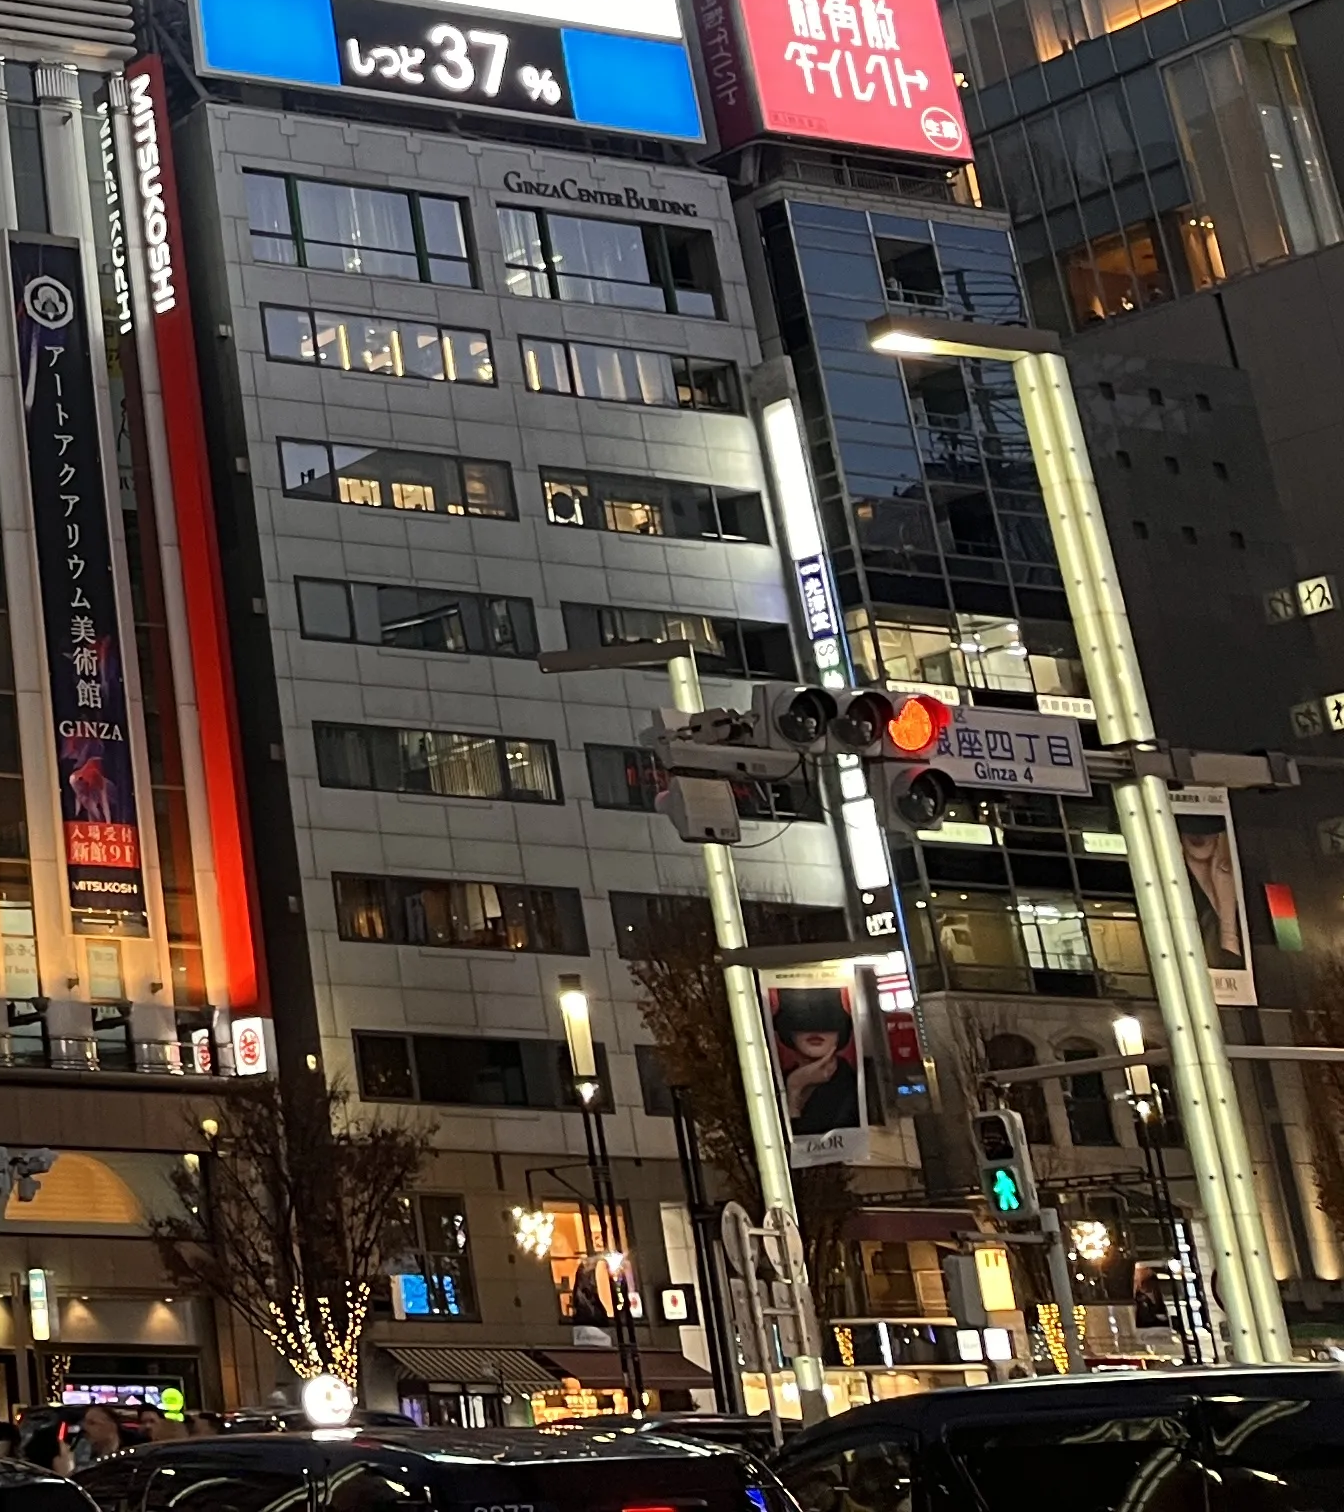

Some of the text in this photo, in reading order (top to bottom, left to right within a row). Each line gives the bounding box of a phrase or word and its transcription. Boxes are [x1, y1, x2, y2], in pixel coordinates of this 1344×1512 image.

[426, 21, 510, 98] 37
[517, 62, 562, 106] %
[129, 72, 176, 314] MITSUKOSHI
[44, 345, 102, 709] アートアクアリウム美術館
[59, 720, 124, 741] GINZA
[974, 762, 1034, 783] Ginza 4
